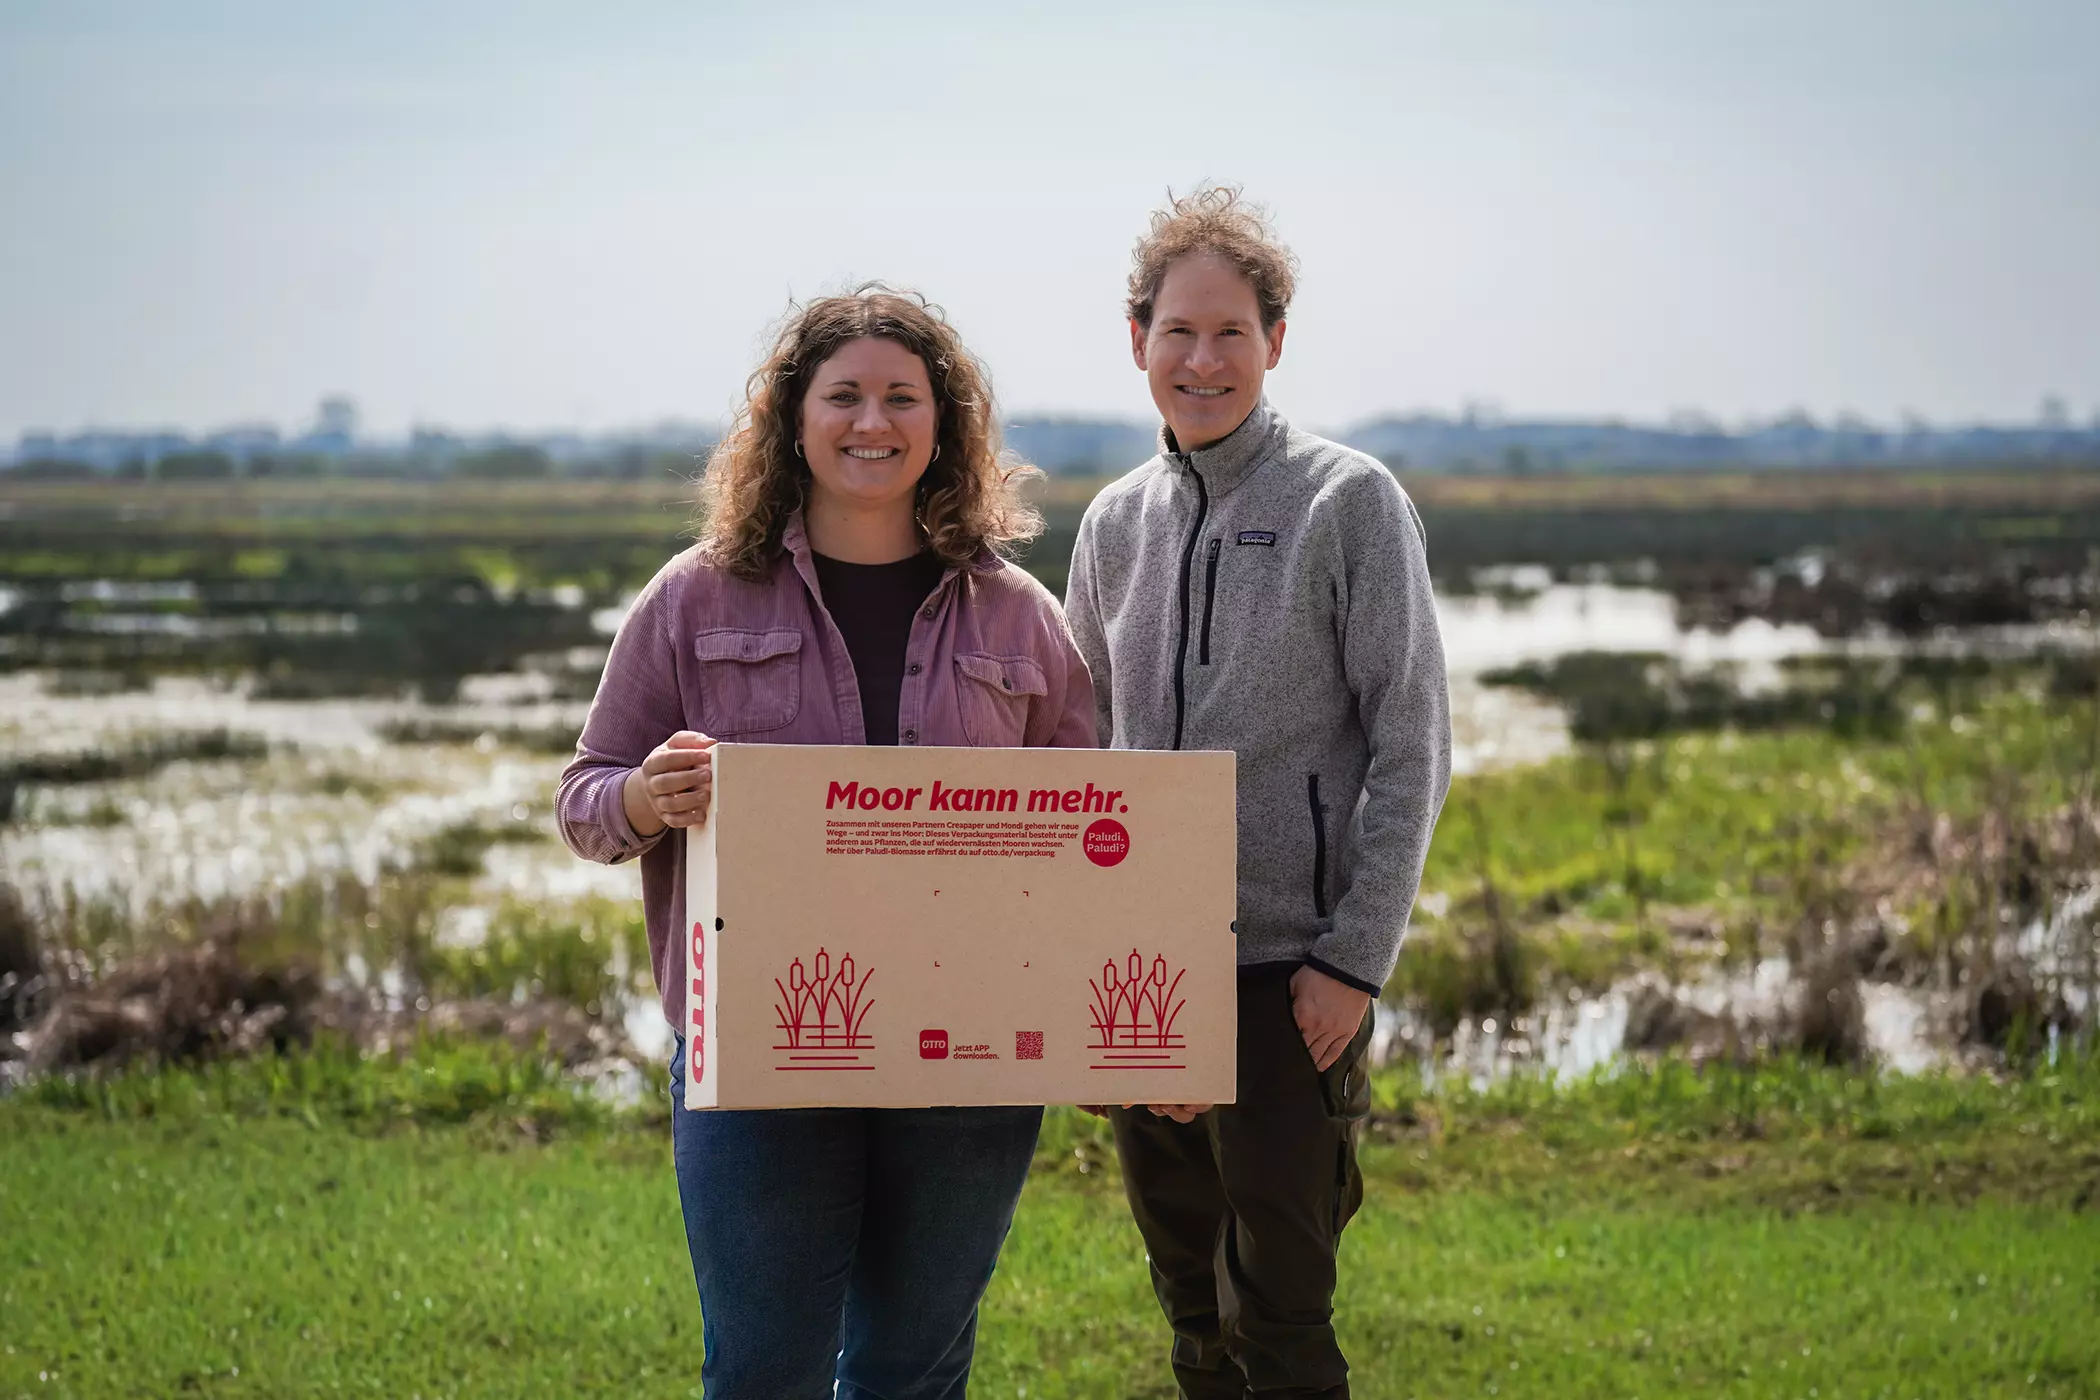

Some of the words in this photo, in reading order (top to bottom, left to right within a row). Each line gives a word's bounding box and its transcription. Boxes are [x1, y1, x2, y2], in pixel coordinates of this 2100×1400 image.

[826, 781, 922, 811] Moor
[929, 780, 1019, 812] kann
[1027, 783, 1128, 813] mehr.
[826, 820, 867, 828] Zusammen
[868, 820, 880, 828] mit
[912, 821, 945, 829] Partnern
[947, 821, 984, 831] Creapaper
[986, 821, 1000, 829] und
[1001, 821, 1023, 829] Mondi
[1024, 822, 1047, 831] gehen
[1048, 822, 1060, 830] wir
[826, 829, 847, 838] Wege
[855, 829, 869, 837] und
[890, 829, 901, 837] ins
[902, 829, 925, 837] Moor:
[925, 830, 950, 838] Dieses
[951, 830, 1027, 840] Verpackungsmaterial
[1029, 831, 1056, 839] besteht
[1058, 831, 1078, 839] unter
[1088, 832, 1124, 841] Paludi.
[826, 838, 859, 846] anderem
[874, 839, 909, 848] Pflanzen,
[910, 838, 921, 847] die
[923, 839, 935, 847] auf
[936, 839, 1001, 848] wiedervernässten
[1002, 840, 1030, 848] Mooren
[1031, 840, 1065, 848] wachsen.
[1087, 843, 1126, 853] Paludi?
[826, 847, 845, 855] Mehr
[846, 847, 863, 856] über
[865, 847, 926, 857] Paludi-Biomasse
[927, 848, 957, 857] erfährst
[958, 848, 968, 856] du
[969, 848, 981, 857] auf
[982, 848, 1056, 858] otto.de/verpackung
[691, 921, 705, 1084] OTTO
[921, 1040, 946, 1049] OTTO
[953, 1052, 1000, 1060] downloaden.
